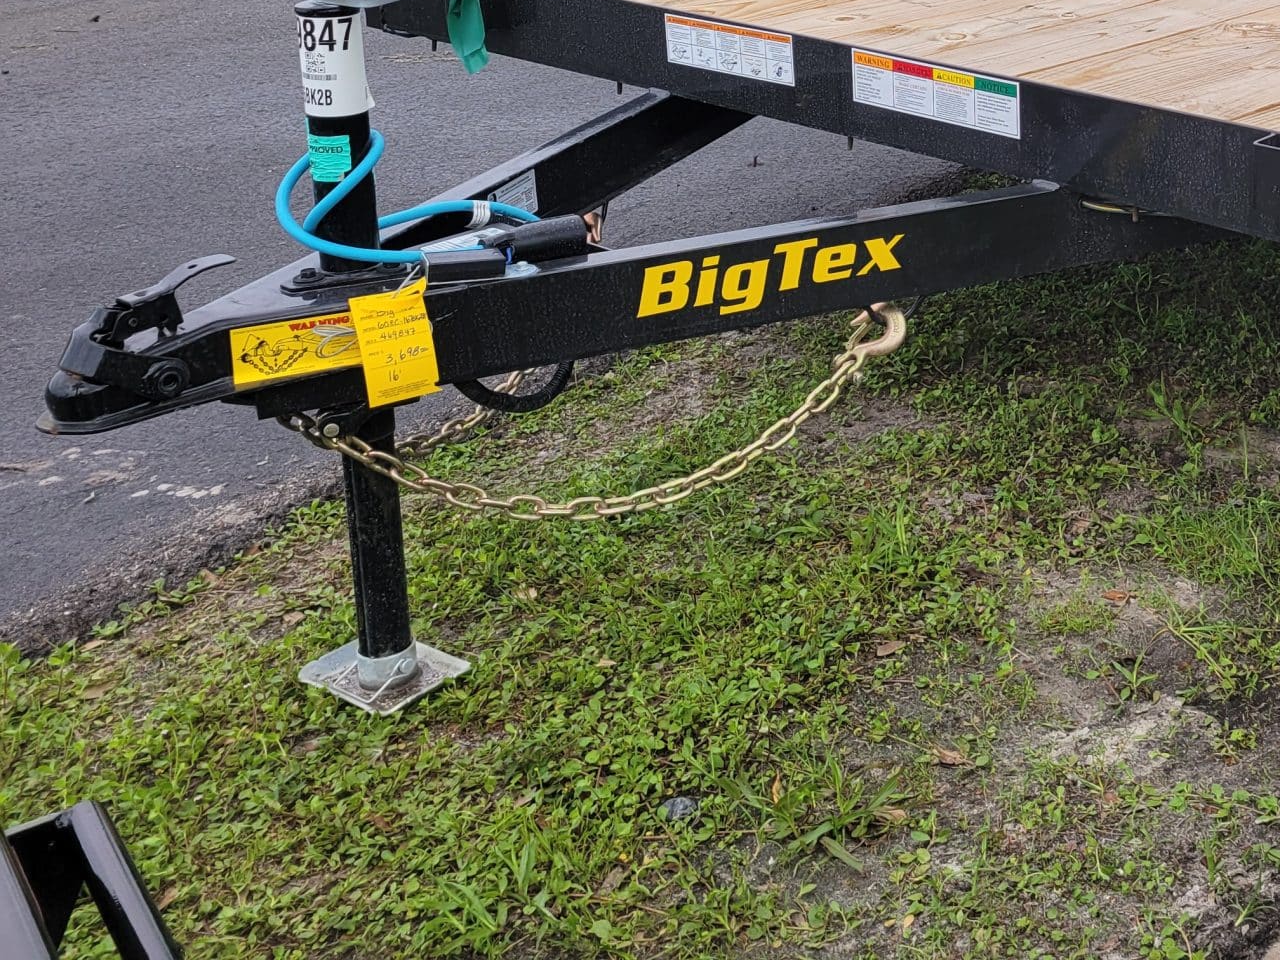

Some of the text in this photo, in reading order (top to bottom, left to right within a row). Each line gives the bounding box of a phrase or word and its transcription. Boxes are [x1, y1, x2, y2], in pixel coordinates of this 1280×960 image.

[857, 55, 890, 69] WARNING
[942, 72, 972, 86] CAUTION
[981, 80, 1010, 94] NOTICE
[637, 234, 905, 318] BigTex
